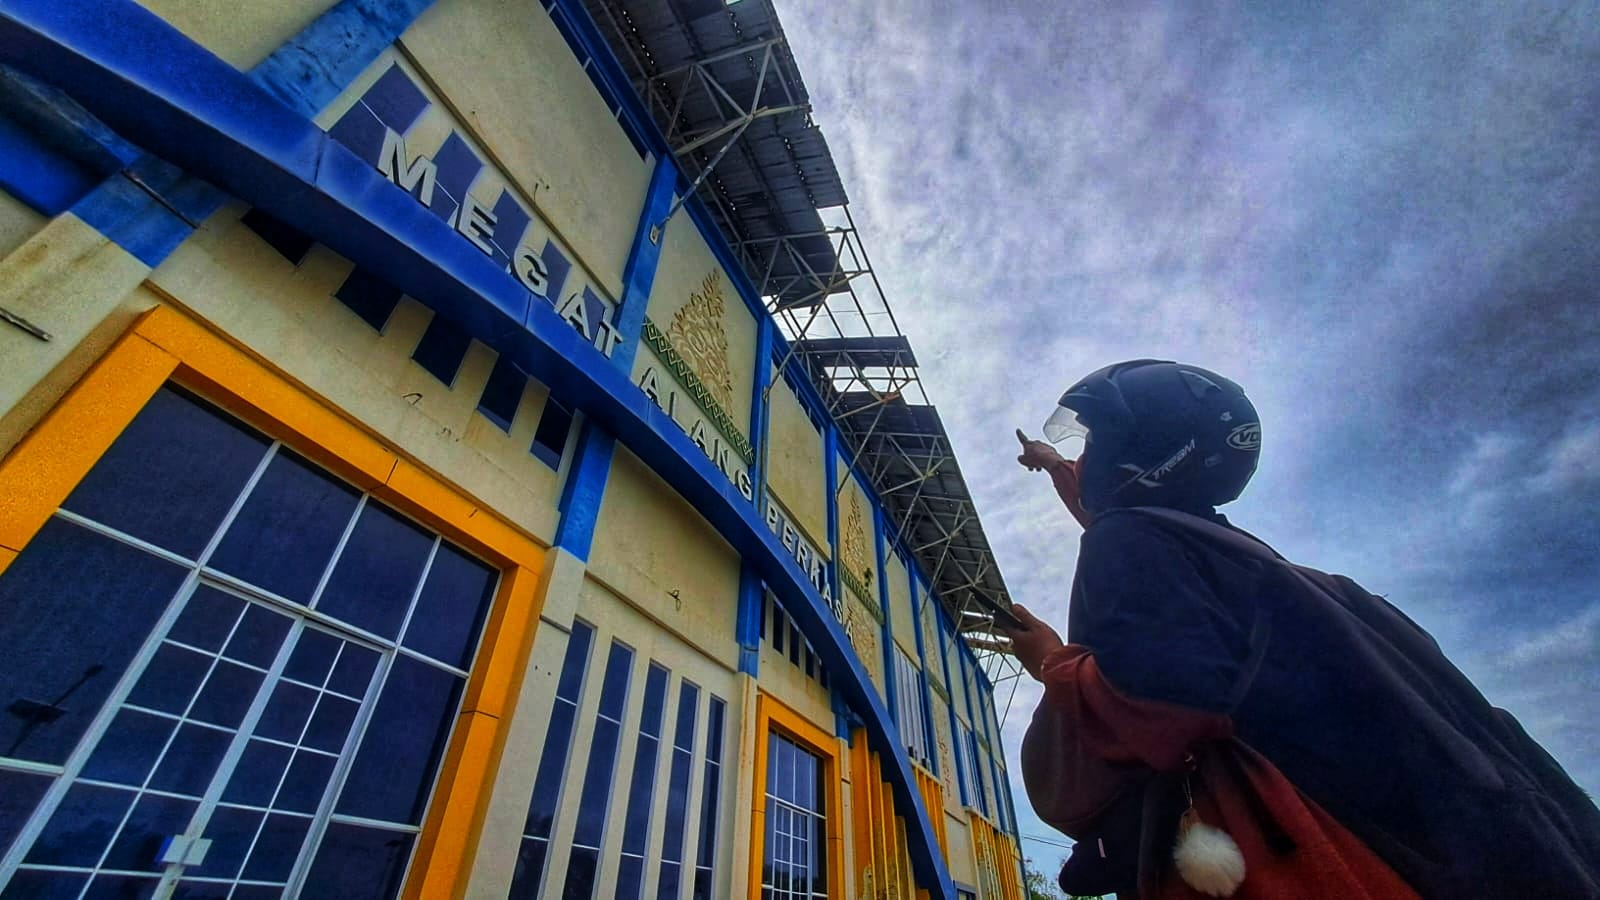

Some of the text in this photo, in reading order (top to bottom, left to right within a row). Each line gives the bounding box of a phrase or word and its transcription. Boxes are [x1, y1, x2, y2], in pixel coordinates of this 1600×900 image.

[377, 126, 855, 650] MEGAT ALANG PERKASA
